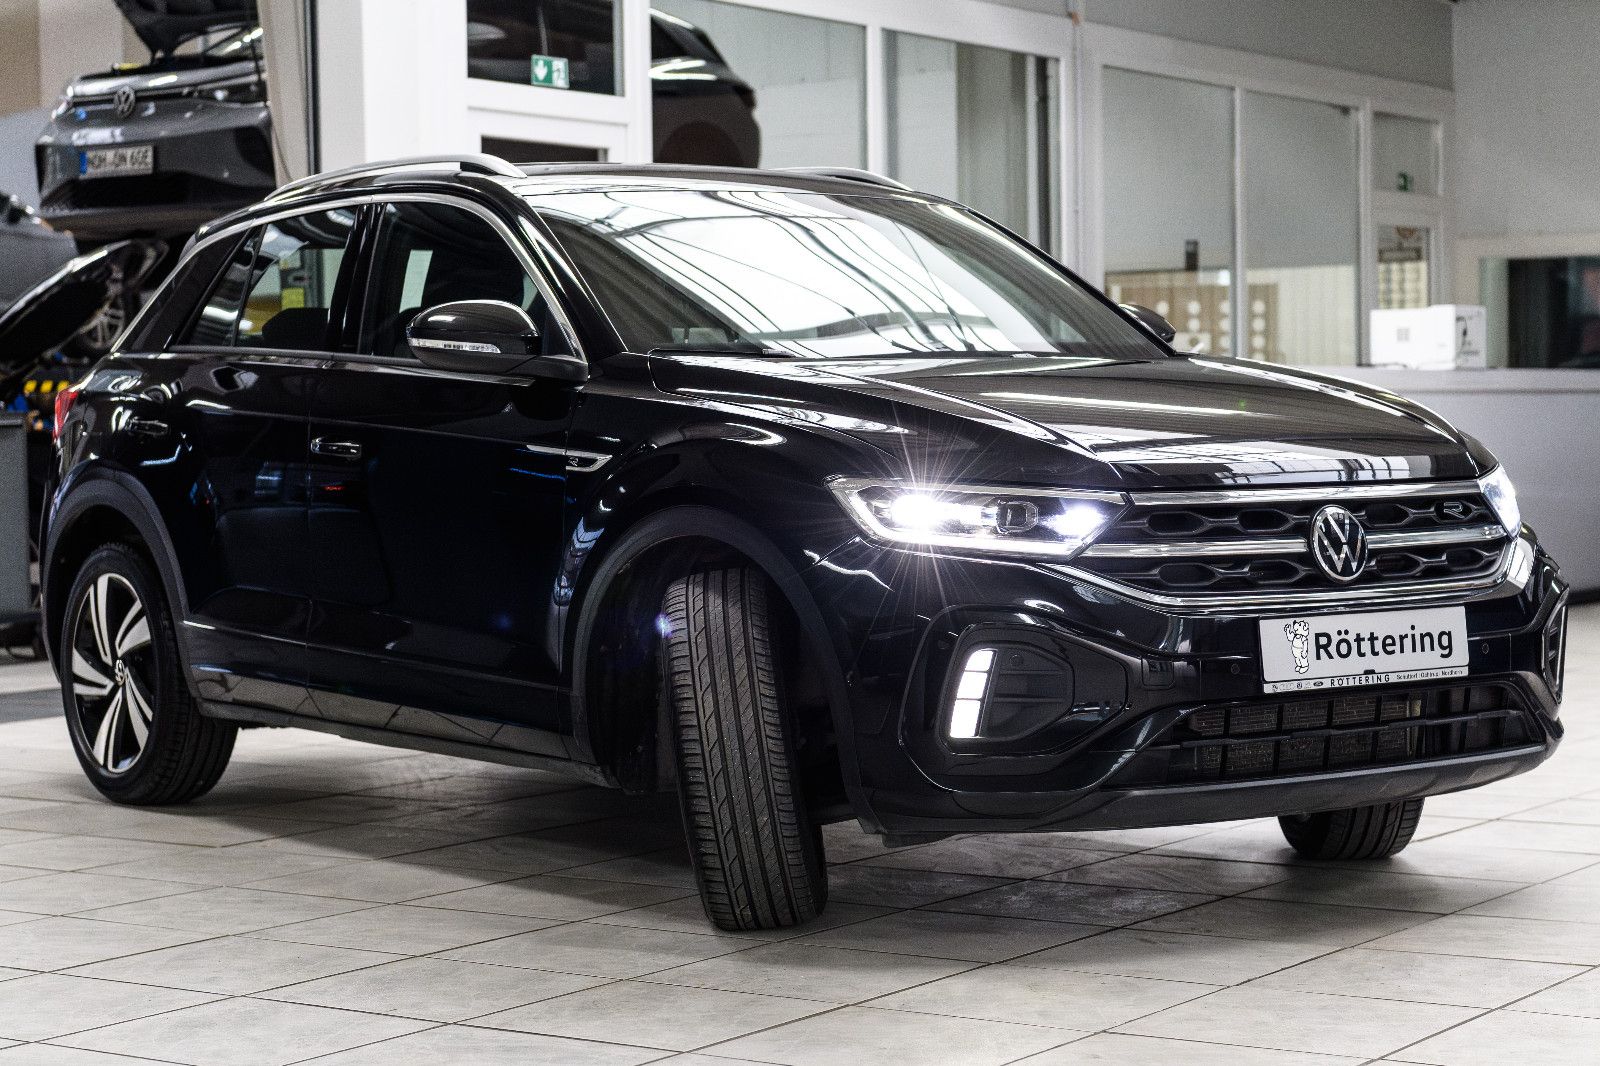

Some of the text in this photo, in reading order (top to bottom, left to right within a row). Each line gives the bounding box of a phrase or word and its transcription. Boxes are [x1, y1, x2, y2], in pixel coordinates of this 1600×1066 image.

[1443, 502, 1465, 519] R
[1314, 624, 1454, 661] Röttering
[1330, 674, 1391, 687] RÖTTERING
